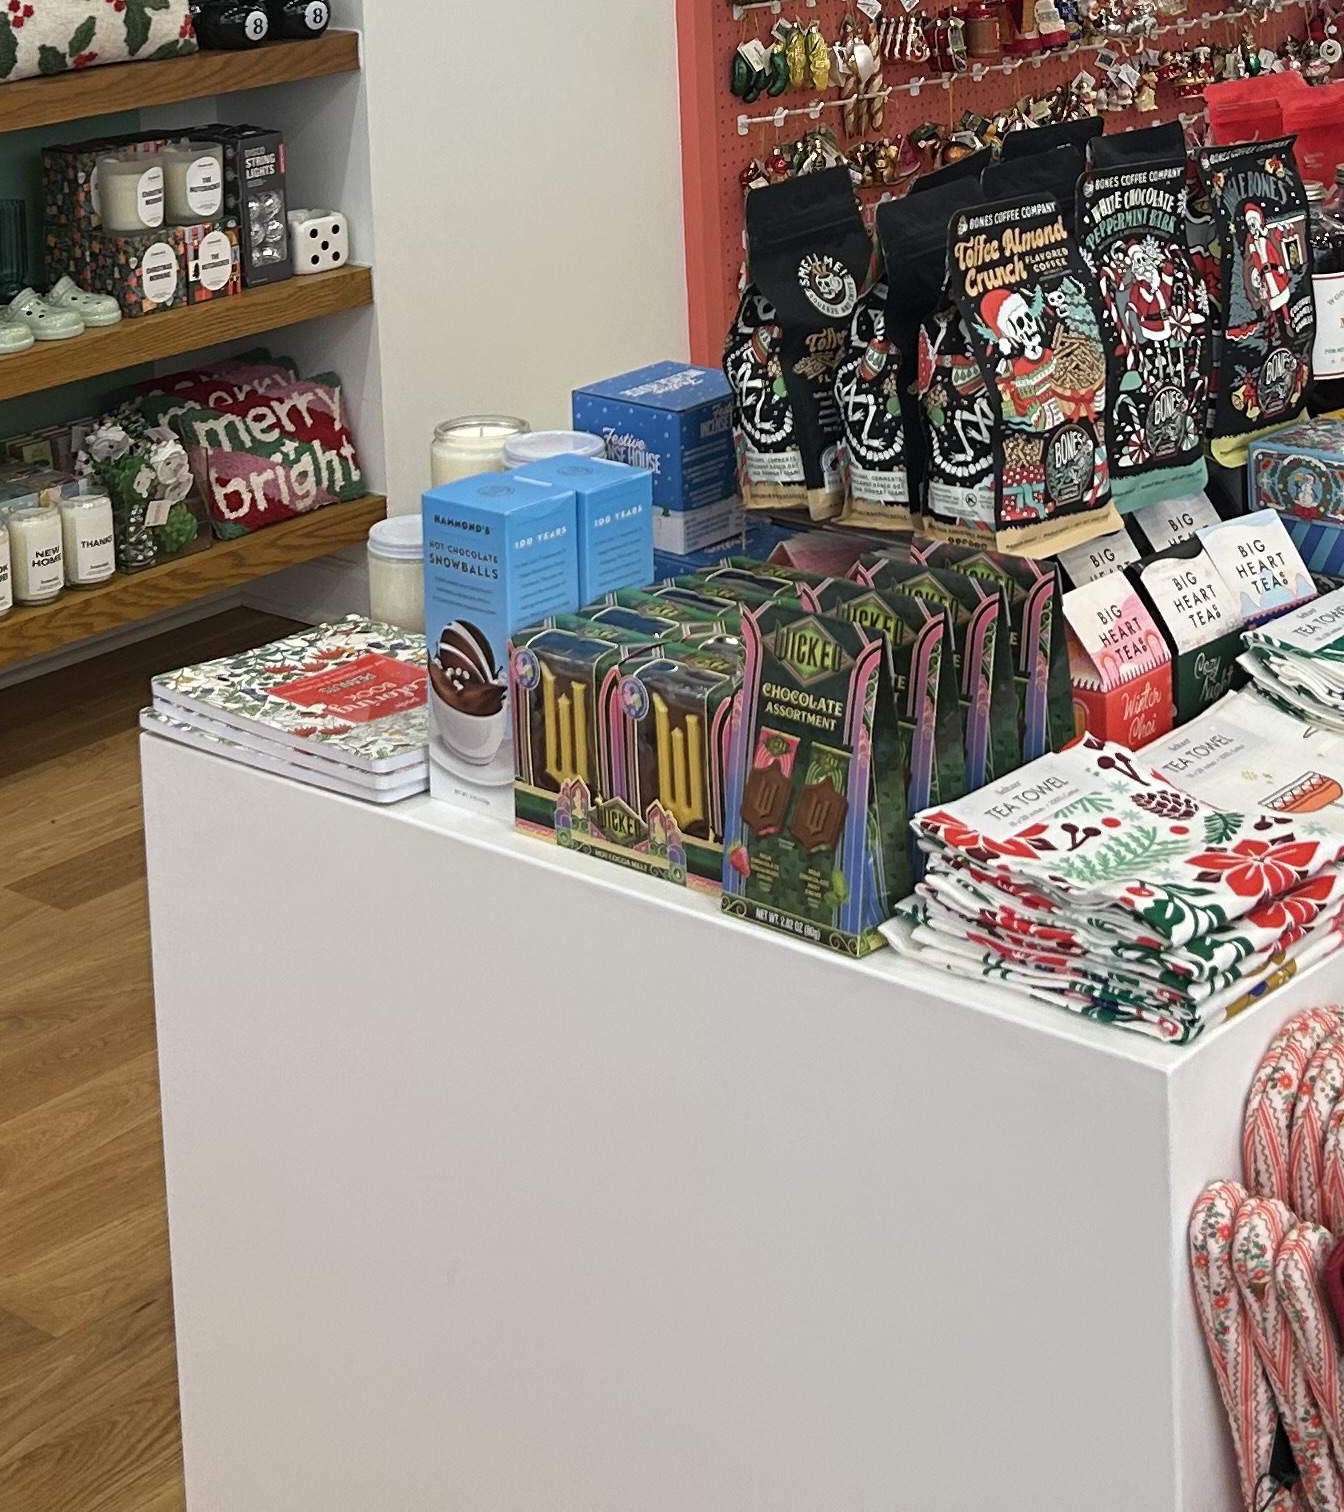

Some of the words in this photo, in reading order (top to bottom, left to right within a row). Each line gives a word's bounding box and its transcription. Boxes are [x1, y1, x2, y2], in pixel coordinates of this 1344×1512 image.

[253, 18, 262, 34] 8
[313, 7, 322, 24] 8
[245, 153, 276, 169] STRING
[246, 165, 275, 180] LIGHTS
[1095, 177, 1119, 191] BONES
[1121, 172, 1147, 186] COFFEE
[1149, 166, 1184, 182] COMPANY
[969, 215, 993, 231] BONES
[994, 208, 1020, 224] COFFEE
[1021, 202, 1056, 220] COMPANY
[1091, 191, 1122, 223] WHITE
[1124, 187, 1175, 213] CHOCOLATE
[1085, 207, 1149, 250] PEPPERMINT
[1149, 208, 1176, 234] BARK
[955, 234, 999, 270] Toffee
[1002, 215, 1068, 257] Almond
[1025, 248, 1069, 264] FLAVORED
[1033, 257, 1068, 273] COFFEE
[965, 256, 1027, 297] Crunch
[193, 386, 342, 455] merry
[603, 427, 646, 450] Festive
[1054, 430, 1082, 468] BONES
[628, 449, 661, 474] HOUSE
[209, 435, 361, 520] bright
[434, 514, 490, 536] HAMMOND'S
[594, 516, 610, 528] 100
[615, 504, 643, 521] YEARS
[1167, 512, 1194, 532] BIG
[514, 538, 533, 549] 100
[537, 526, 567, 542] YEARS
[1237, 539, 1266, 559] BIG
[32, 553, 62, 568] HOME
[35, 545, 60, 558] NEW
[430, 540, 446, 550] HOT
[448, 545, 499, 564] CHOCOLATE
[1089, 548, 1116, 569] BIG
[430, 553, 499, 580] SNOWBALLS
[1236, 552, 1285, 579] HEART
[1172, 571, 1197, 592] BIG
[1174, 583, 1217, 614] HEART
[1096, 604, 1122, 626] BIG
[1099, 616, 1144, 648] HEART
[1292, 621, 1323, 638] TEA
[774, 626, 843, 673] WICKED
[762, 682, 843, 717] CHOCOLATE
[1121, 681, 1162, 721] Winter
[764, 701, 837, 732] ASSORTMENT
[1129, 713, 1157, 746] Chai
[1162, 756, 1195, 774] TEA
[1185, 733, 1234, 759] TOWEL
[984, 801, 1021, 821] TEA
[1013, 776, 1069, 805] TOWEL
[756, 908, 768, 919] NET
